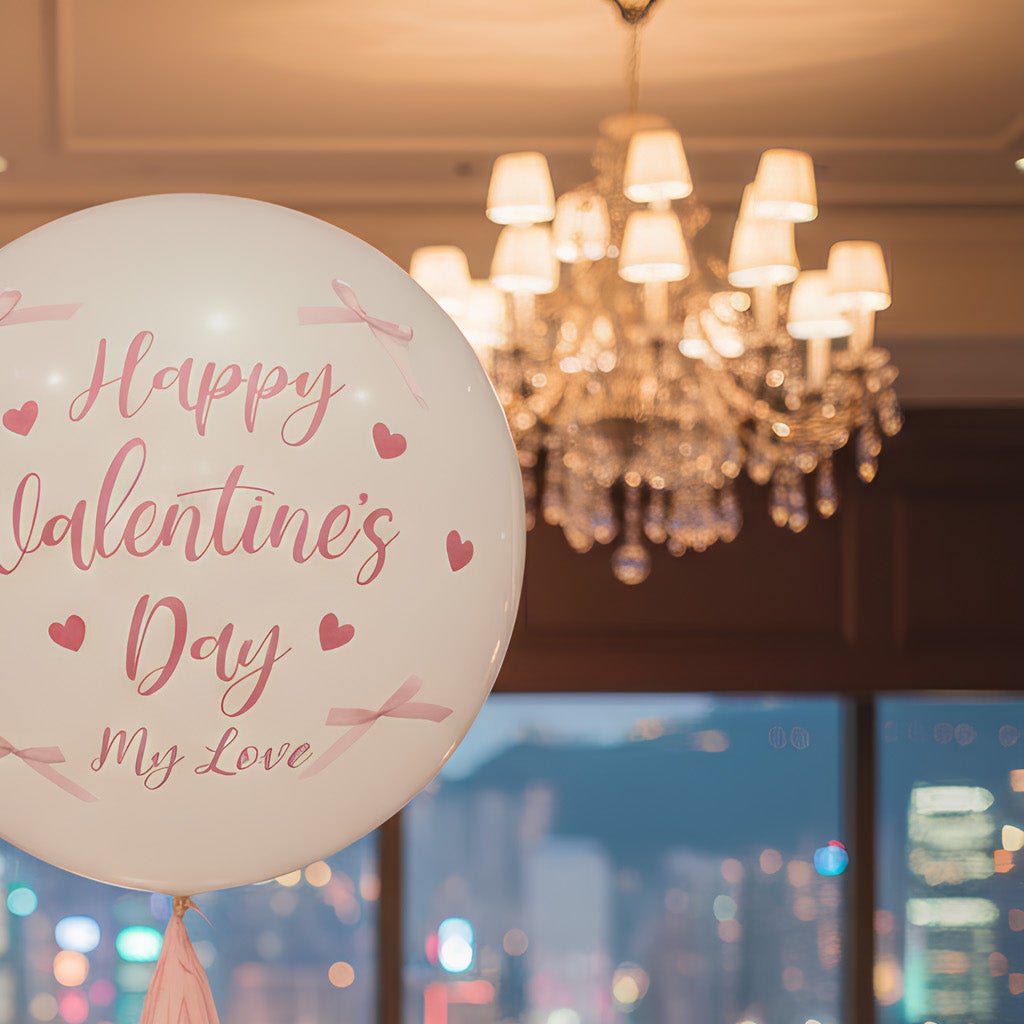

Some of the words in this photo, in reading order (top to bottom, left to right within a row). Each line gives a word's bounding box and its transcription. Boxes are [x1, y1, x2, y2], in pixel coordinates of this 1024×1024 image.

[69, 330, 346, 447] Happy
[125, 594, 292, 717] Day
[90, 726, 185, 790] My
[194, 726, 313, 776] Love
